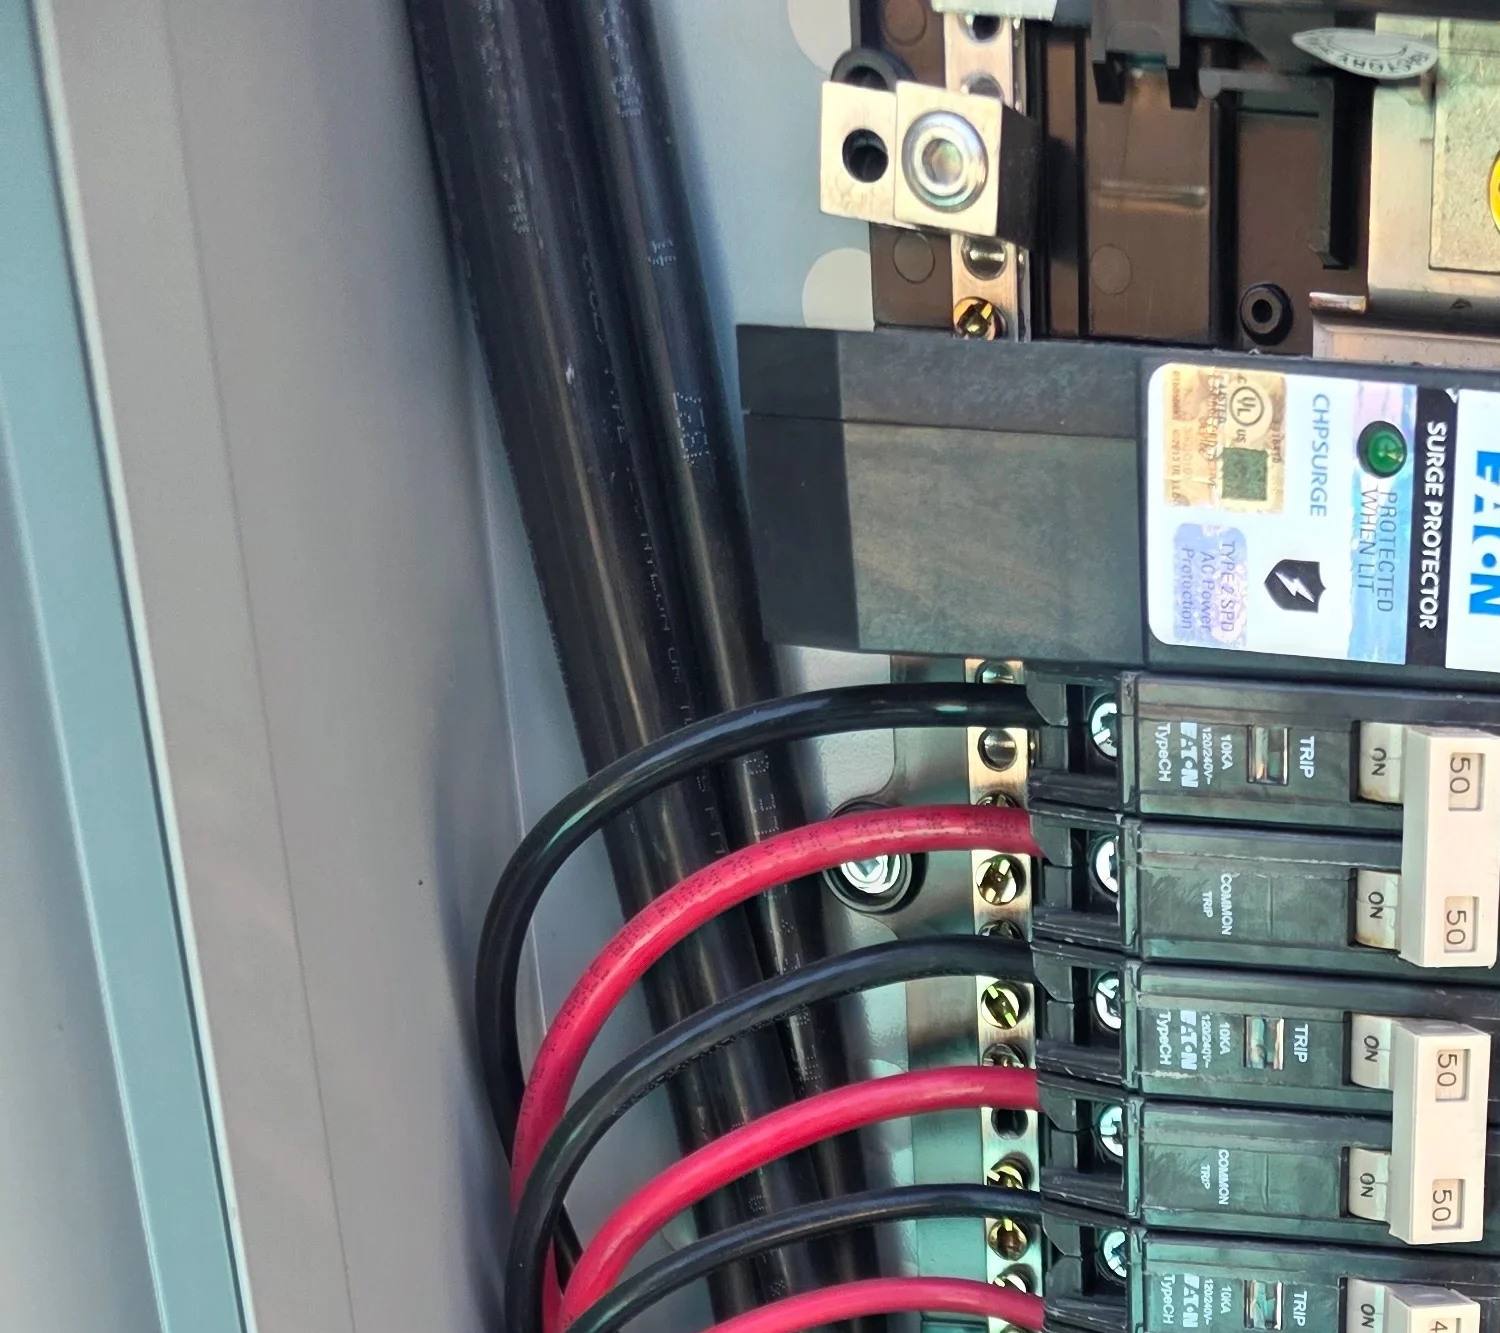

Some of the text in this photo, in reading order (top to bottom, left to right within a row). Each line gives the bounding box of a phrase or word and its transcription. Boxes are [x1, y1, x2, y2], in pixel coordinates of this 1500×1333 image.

[1310, 393, 1330, 518] CHPSURGE
[1358, 486, 1379, 594] WHEN LIT
[1419, 420, 1448, 631] SURGE PROTECTOR
[1376, 491, 1399, 613] PROTECTED
[1180, 547, 1195, 630] Protection
[1199, 551, 1214, 633] AC Power
[1220, 540, 1236, 633] TYPE 2 SPD
[1299, 736, 1315, 778] TRIP
[1371, 747, 1387, 776] ON
[1450, 757, 1470, 795] 50
[1368, 891, 1384, 919] ON
[1446, 910, 1467, 945] 50
[1294, 1023, 1309, 1062] TRIP
[1364, 1034, 1379, 1062] ON
[1437, 1053, 1457, 1087] 50
[1360, 1171, 1374, 1199] ON
[1432, 1188, 1452, 1221] 50
[1293, 1290, 1308, 1327] TRIP
[1360, 1303, 1375, 1328] ON
